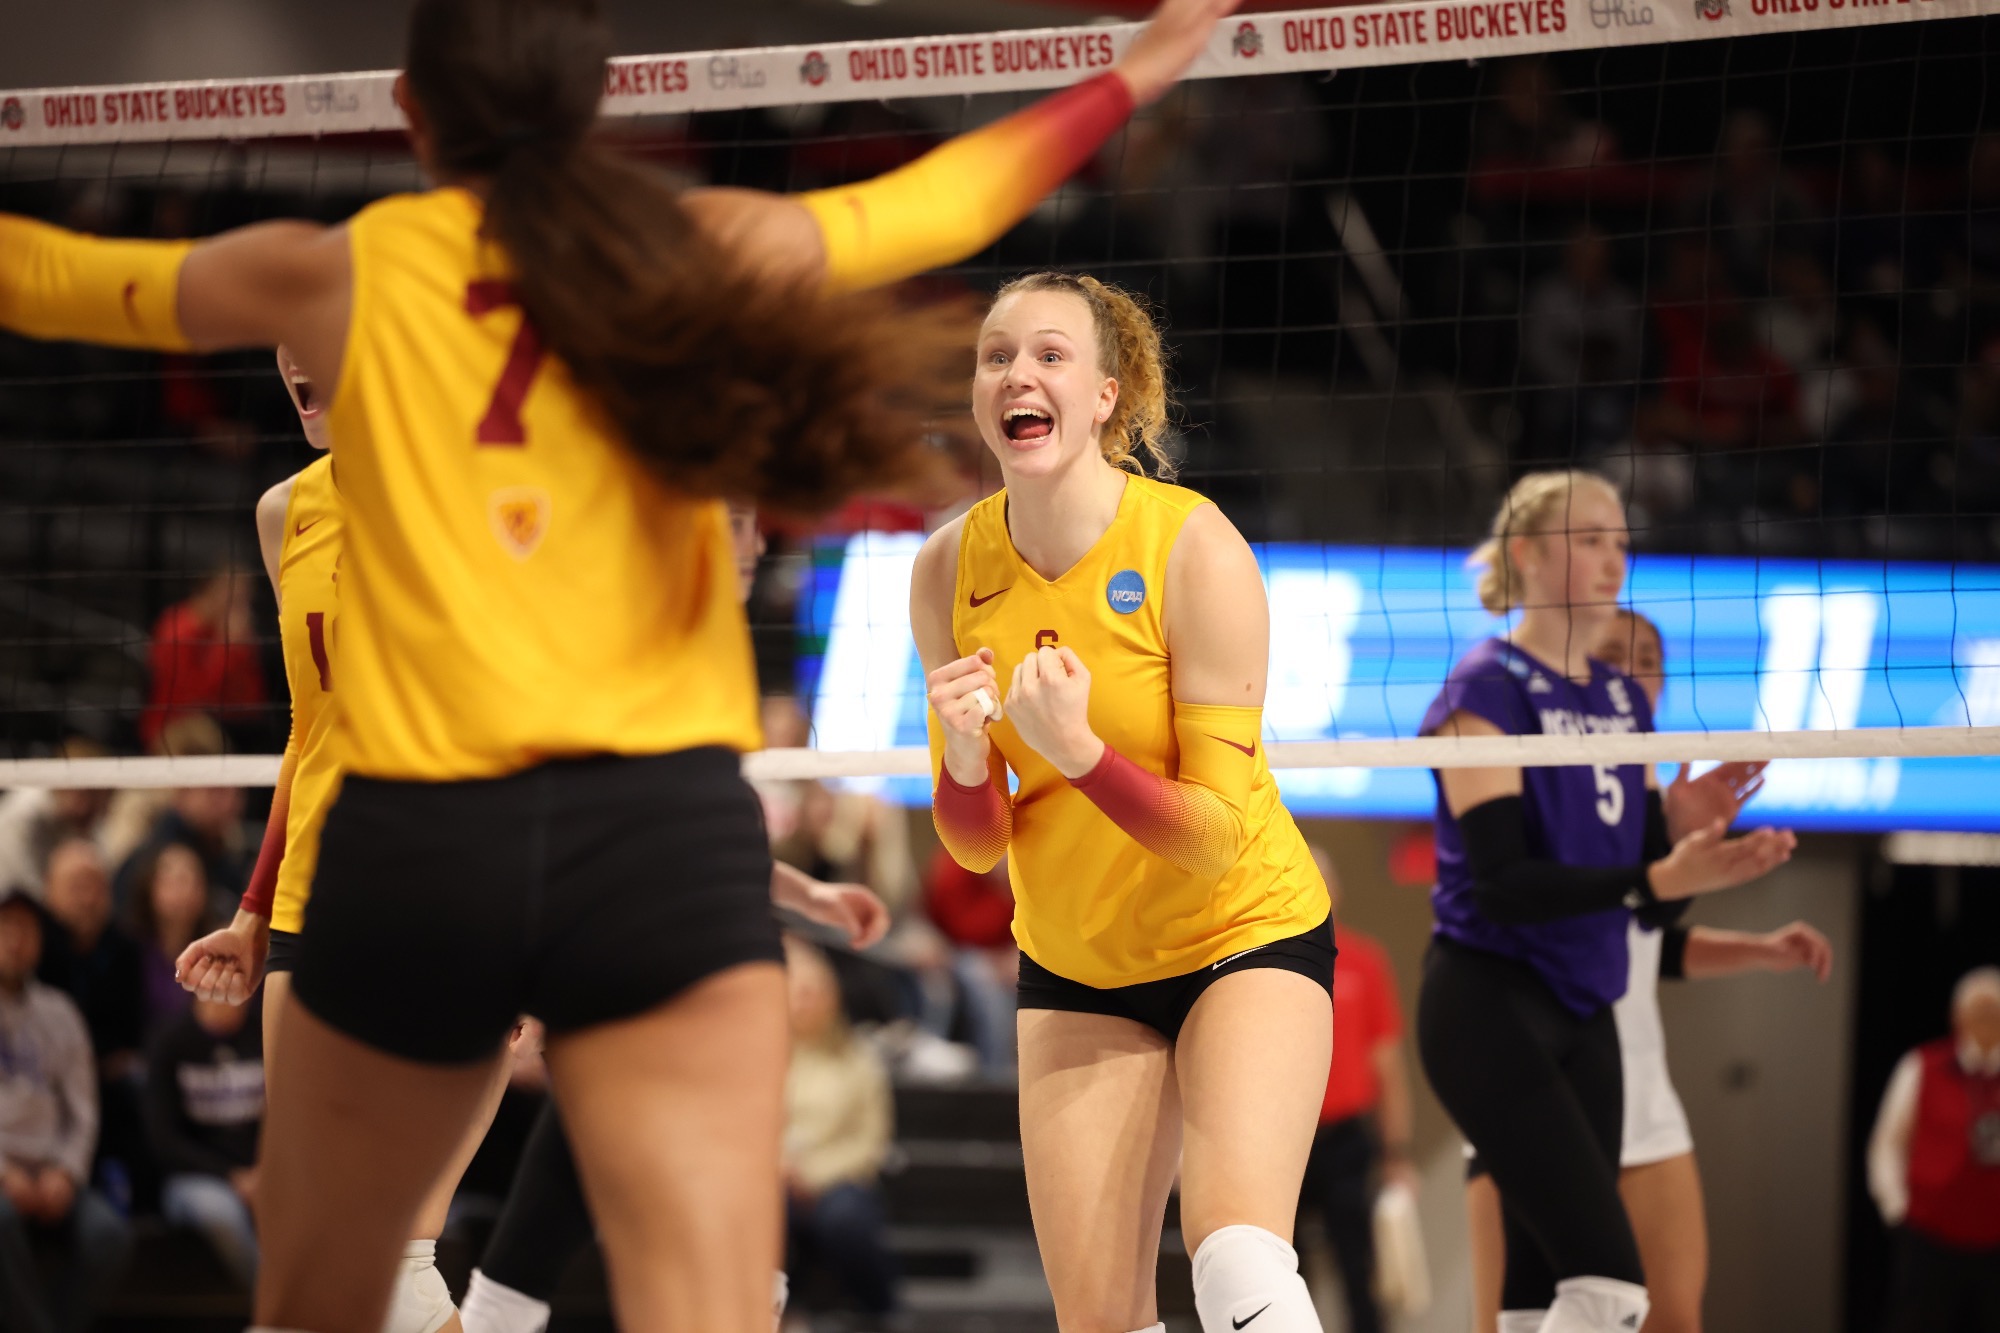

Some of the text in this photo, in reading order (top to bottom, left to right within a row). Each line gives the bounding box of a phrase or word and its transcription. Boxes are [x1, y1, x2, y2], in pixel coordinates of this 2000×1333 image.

[1284, 18, 1346, 53] OHIO
[1353, 10, 1427, 48] STATE
[1435, 0, 1566, 42] BUCKEYES
[605, 61, 688, 96] CKEYES
[848, 47, 908, 82] OHIO
[913, 42, 984, 78] STATE
[992, 34, 1114, 72] BUCKEYES
[44, 95, 97, 128] OHIO
[104, 90, 167, 124] STATE
[175, 84, 286, 121] BUCKEYES
[1111, 589, 1143, 603] NCAA
[306, 612, 335, 692] 1
[1592, 763, 1624, 826] 5
